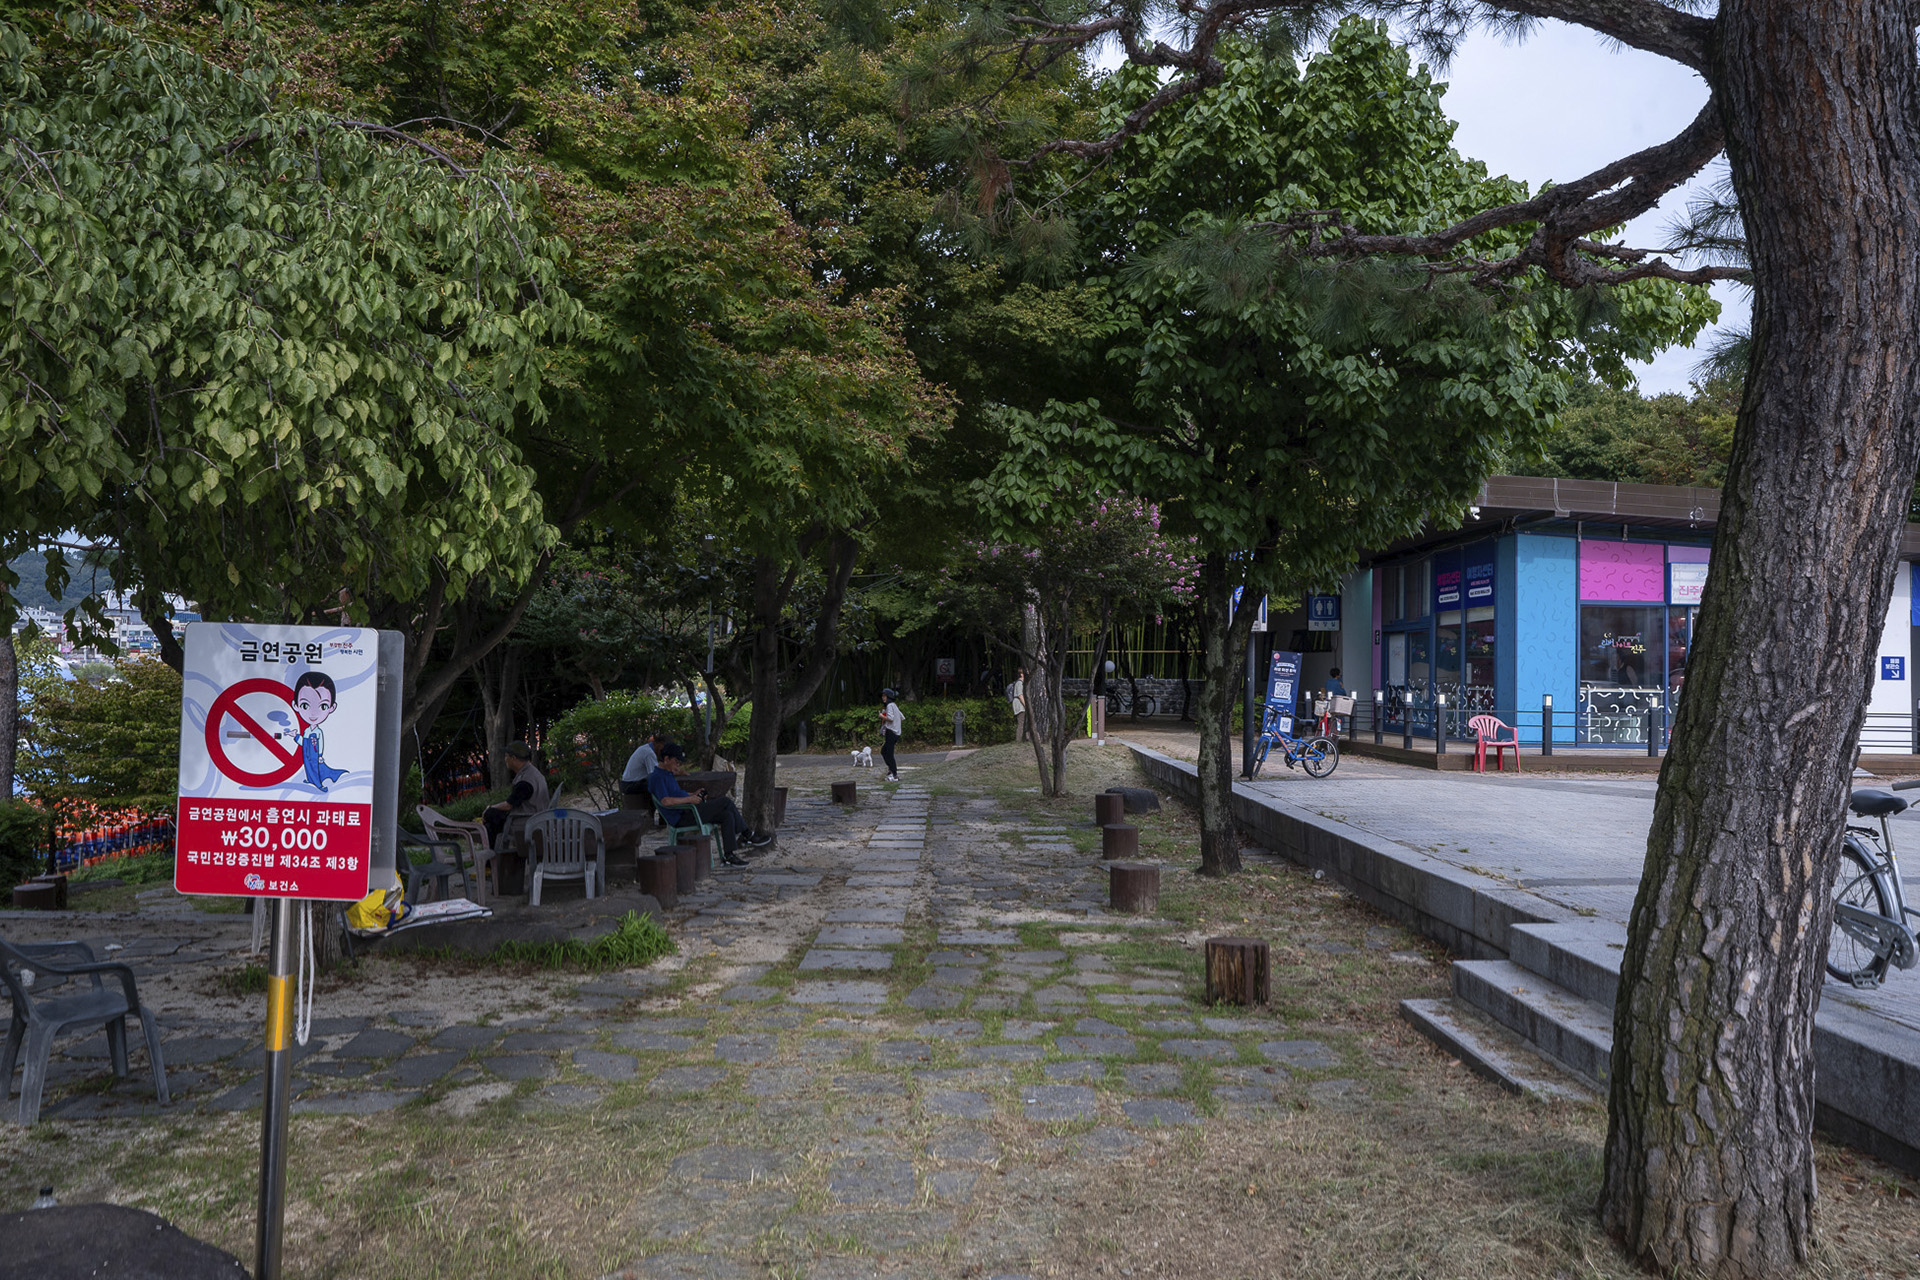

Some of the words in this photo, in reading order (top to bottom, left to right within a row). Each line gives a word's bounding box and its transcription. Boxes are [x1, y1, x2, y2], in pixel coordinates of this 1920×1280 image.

[1679, 585, 1704, 596] 진주
[240, 641, 322, 664] 금연공원
[188, 807, 262, 823] 금연공원에서
[266, 807, 310, 825] 흡연시
[316, 809, 361, 827] 과태료
[221, 826, 328, 851] ₩30,000
[187, 850, 275, 868] 국민건강증진법
[279, 854, 321, 869] 제34조
[325, 856, 359, 871] 제3항
[268, 880, 299, 891] 보건소
